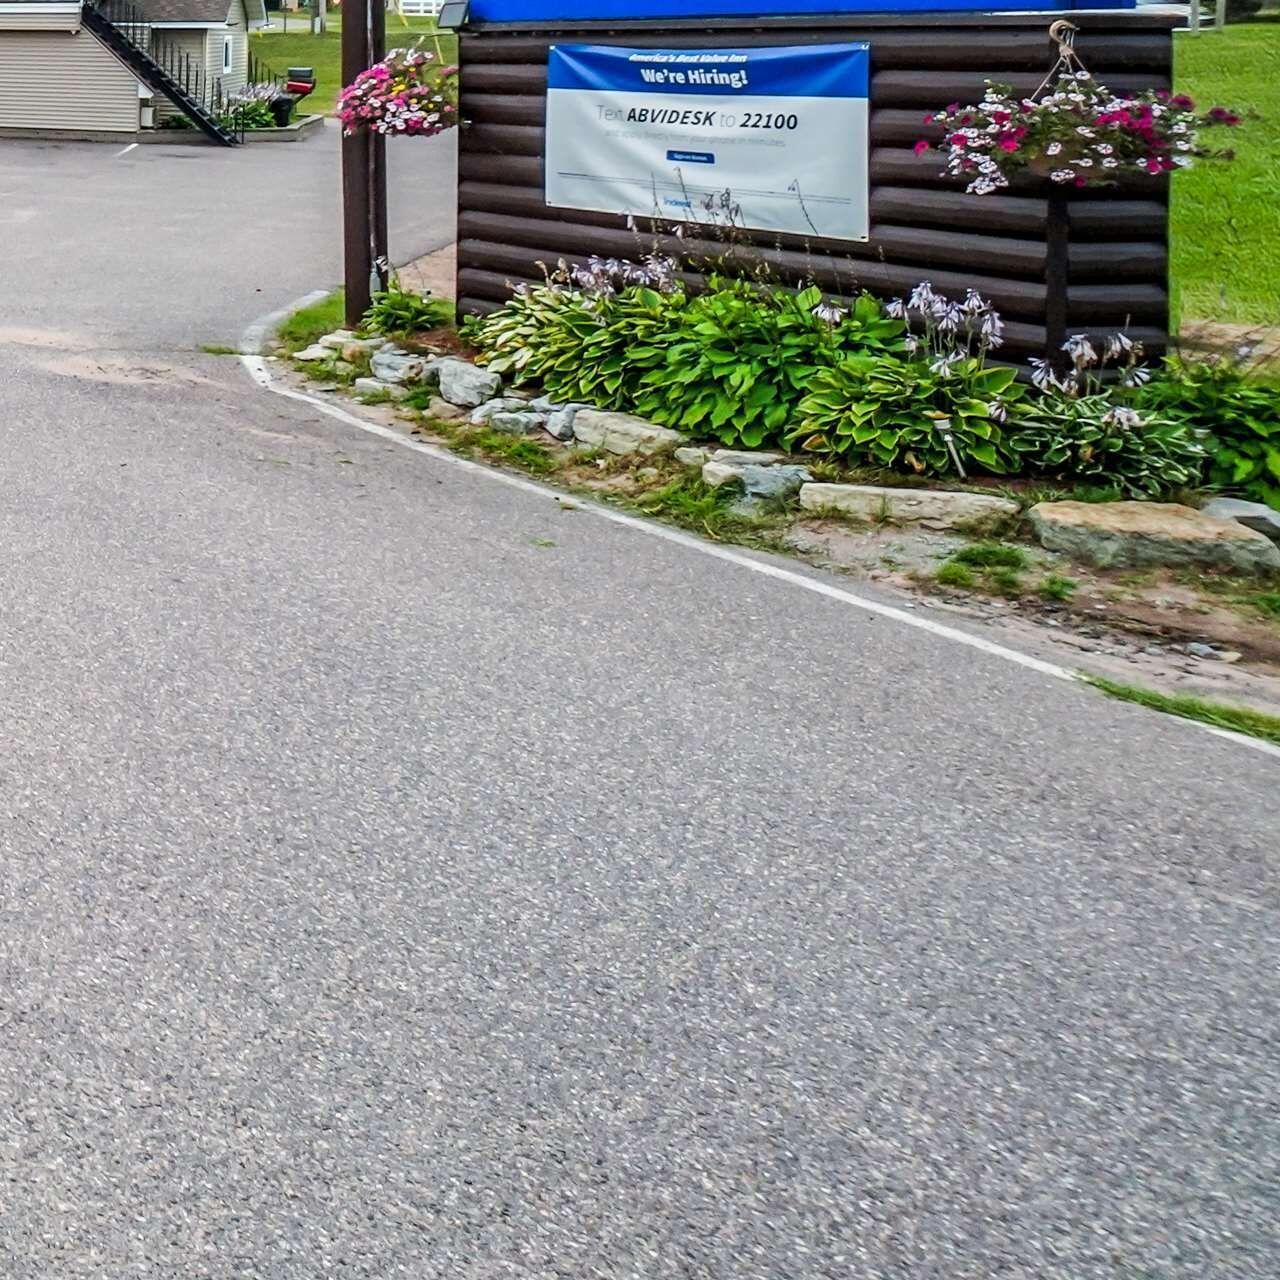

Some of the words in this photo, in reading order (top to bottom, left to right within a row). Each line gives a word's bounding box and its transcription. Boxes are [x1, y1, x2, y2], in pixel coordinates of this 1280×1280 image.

[640, 68, 685, 84] We're
[689, 69, 748, 89] Hiring!
[627, 107, 716, 127] ABVIDESK
[720, 113, 736, 128] to
[739, 112, 798, 130] 22100
